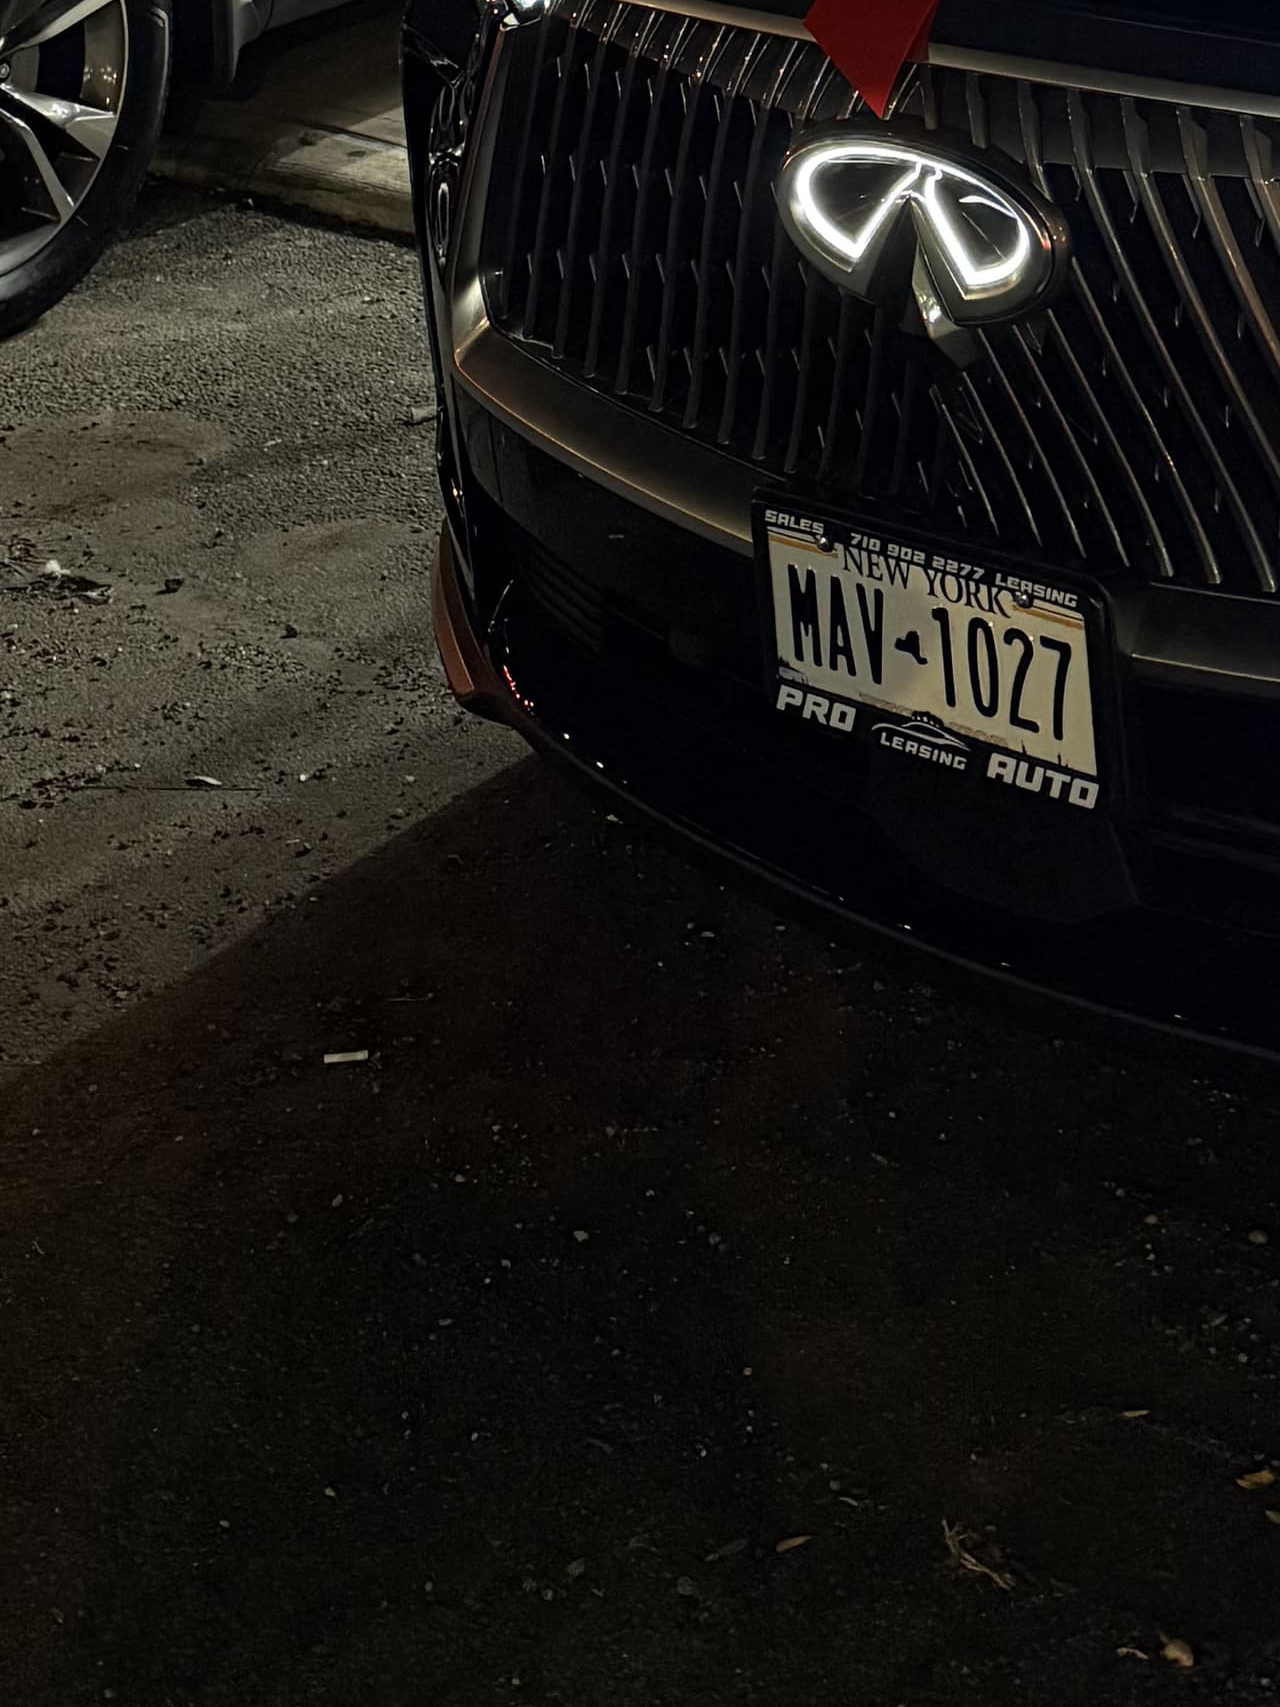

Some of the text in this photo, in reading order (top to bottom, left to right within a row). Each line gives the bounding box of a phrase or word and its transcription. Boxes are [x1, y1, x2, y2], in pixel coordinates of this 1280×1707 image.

[764, 508, 825, 535] SALES
[887, 542, 926, 565] 902
[932, 554, 985, 581] 2277
[994, 571, 1079, 608] LEASING
[841, 546, 1012, 619] NEW YORK
[787, 563, 885, 685] MAV
[931, 606, 1073, 741] 1027
[775, 683, 857, 733] PRO
[879, 730, 971, 771] LEASING
[986, 751, 1100, 810] AUTO
